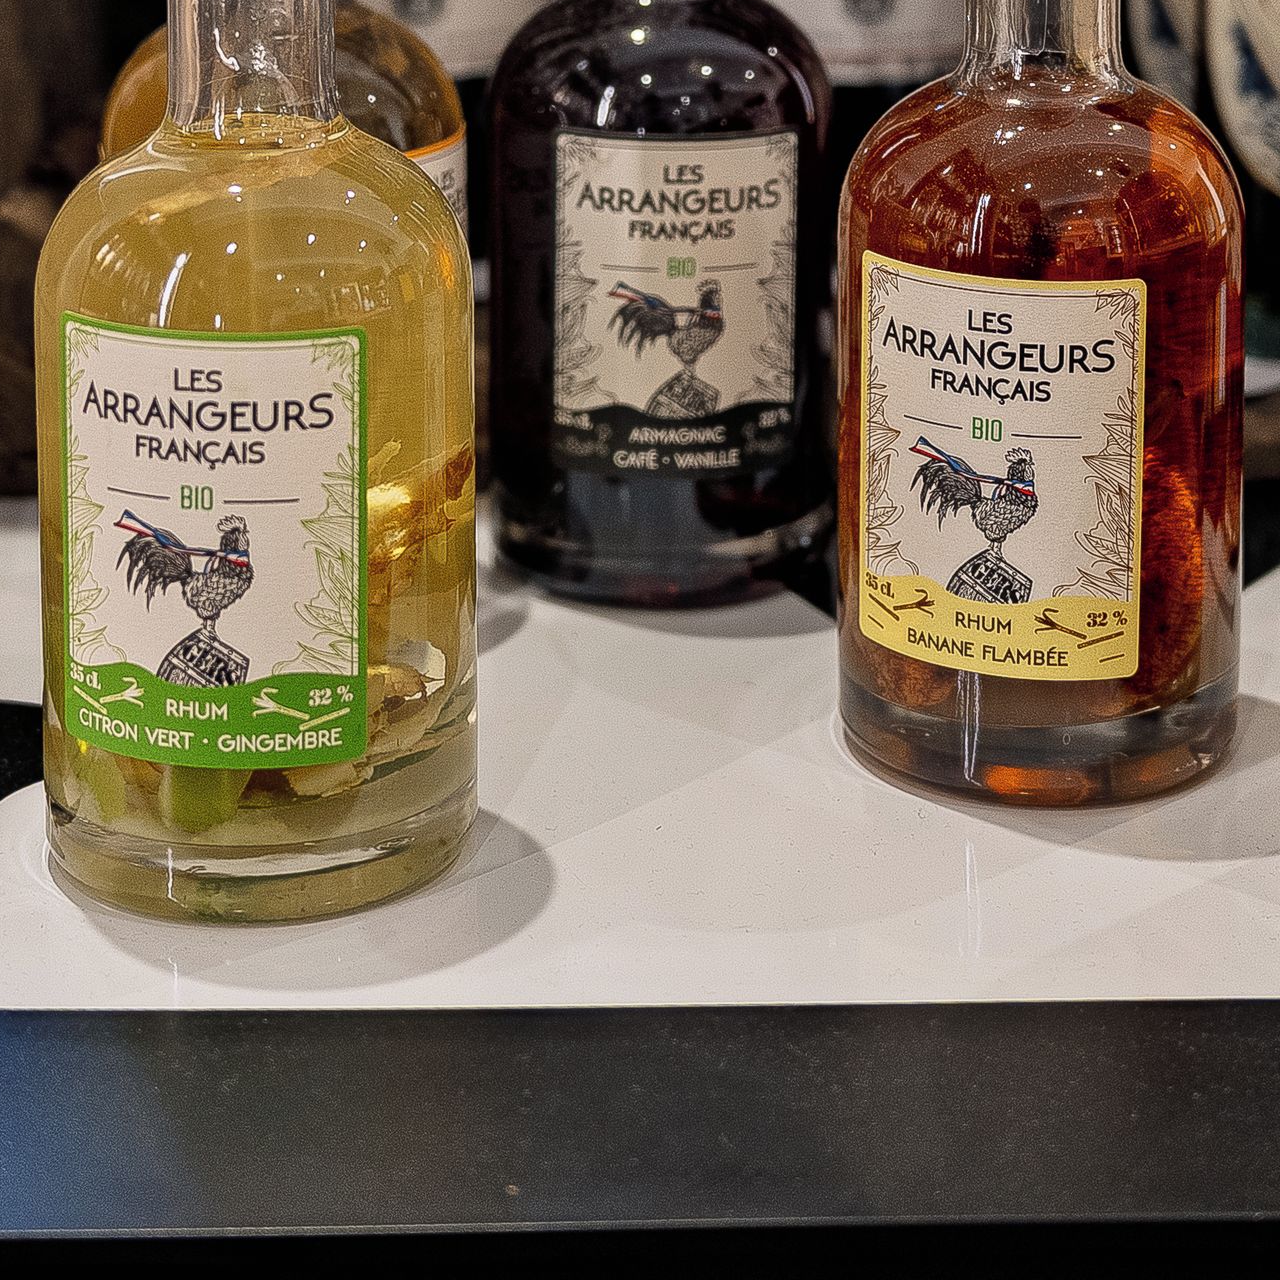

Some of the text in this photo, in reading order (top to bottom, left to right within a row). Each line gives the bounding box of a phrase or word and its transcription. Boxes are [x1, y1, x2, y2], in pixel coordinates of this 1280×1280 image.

[663, 164, 704, 185] LES
[576, 179, 782, 215] ARRANGEURS
[628, 220, 737, 244] FRANÇAIS
[666, 256, 698, 280] BIO
[967, 309, 1013, 334] LES
[882, 316, 1116, 374] ARRANGEURS
[174, 367, 222, 392] LES
[930, 369, 1052, 405] FRANÇAIS
[82, 381, 335, 433] ARRANGEURS
[971, 417, 1003, 442] BIO
[134, 435, 266, 470] FRANÇAIS
[180, 485, 213, 511] BIO
[955, 611, 1012, 635] RHUM
[1086, 610, 1128, 627] 32 %
[907, 627, 1069, 667] BANANE FLAMBÉE
[308, 685, 354, 708] 32 %
[166, 698, 228, 721] RHUM
[79, 708, 343, 753] CITRON VERT GINGEMBRE
